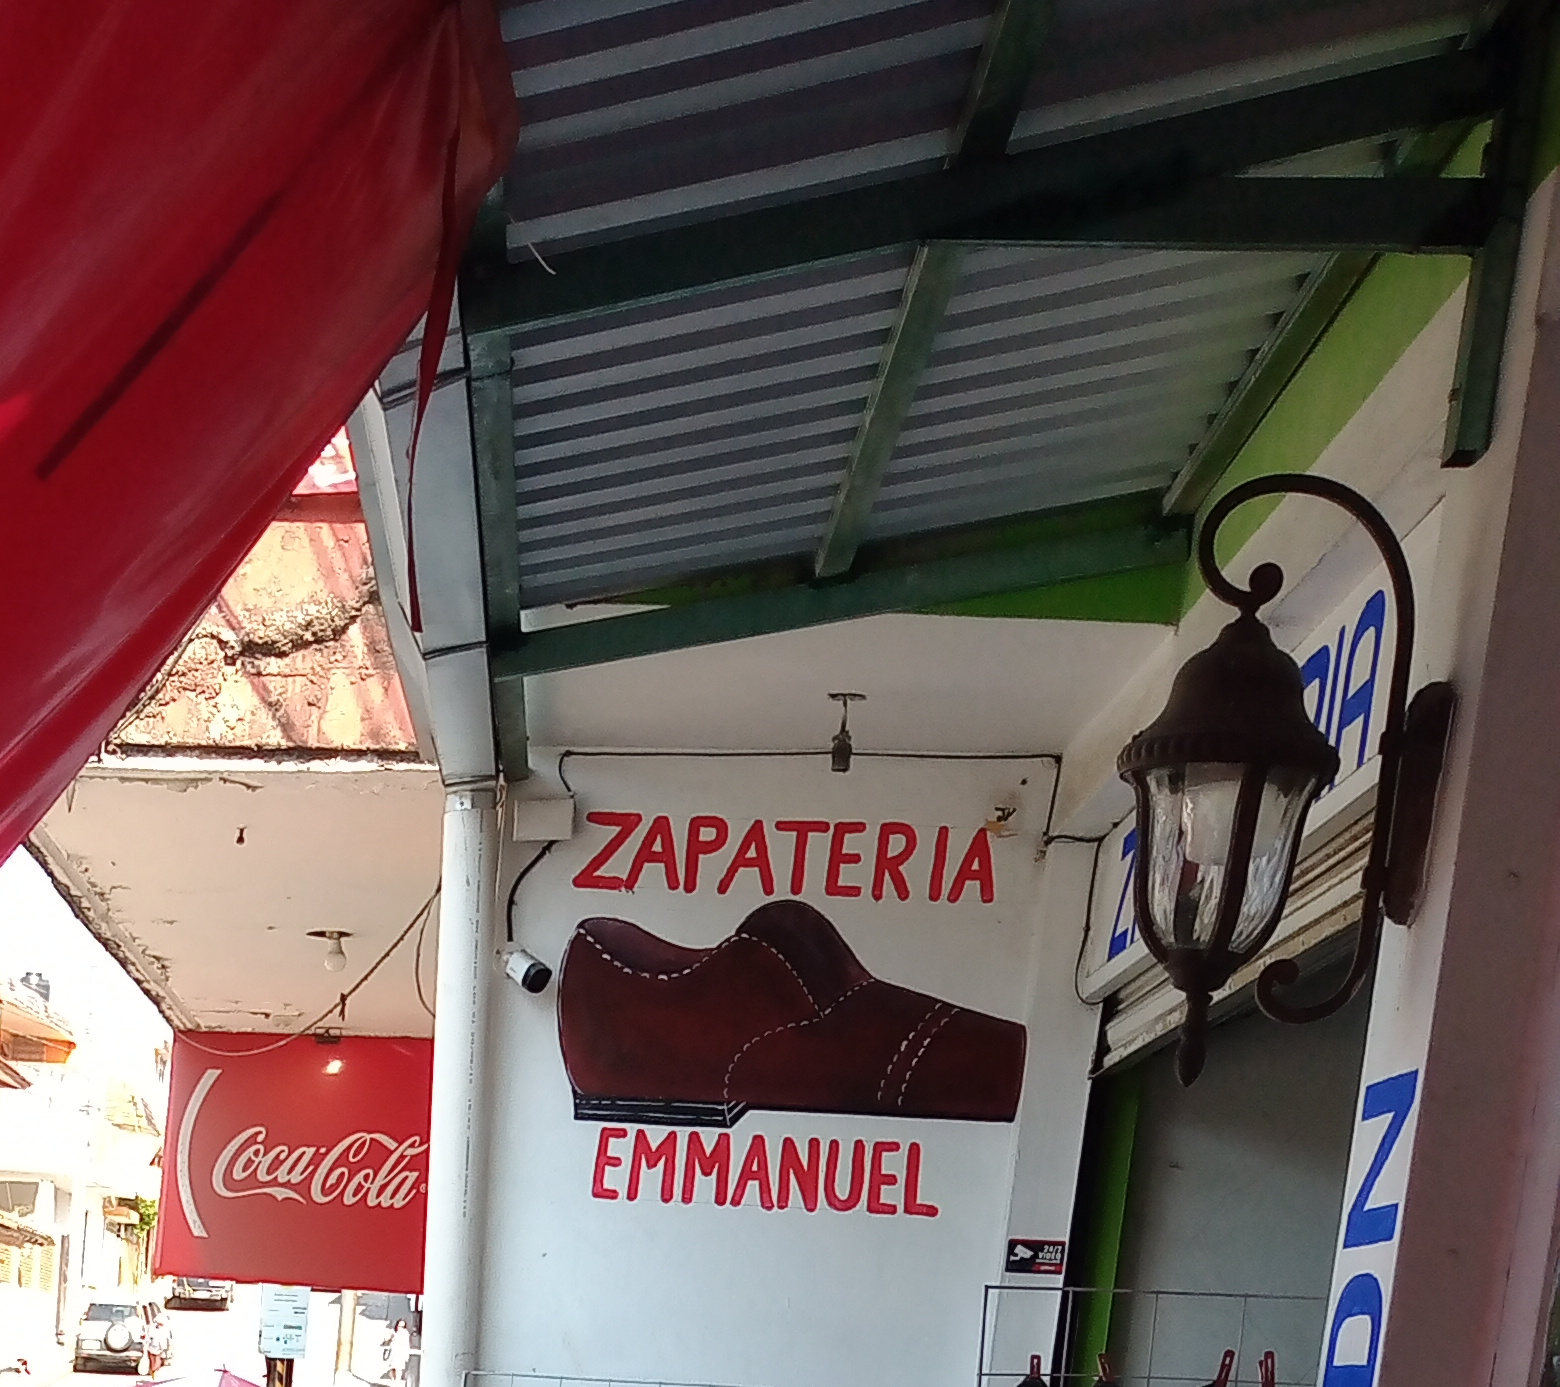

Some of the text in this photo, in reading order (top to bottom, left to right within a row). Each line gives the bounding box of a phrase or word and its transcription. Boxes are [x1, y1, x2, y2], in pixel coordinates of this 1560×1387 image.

[573, 812, 993, 903] ZAPATERIA
[212, 1125, 429, 1209] Coca-Cola
[593, 1128, 938, 1217] EMMANUEL
[1038, 1251, 1062, 1260] VIDEO
[1043, 1244, 1063, 1253] 24/7
